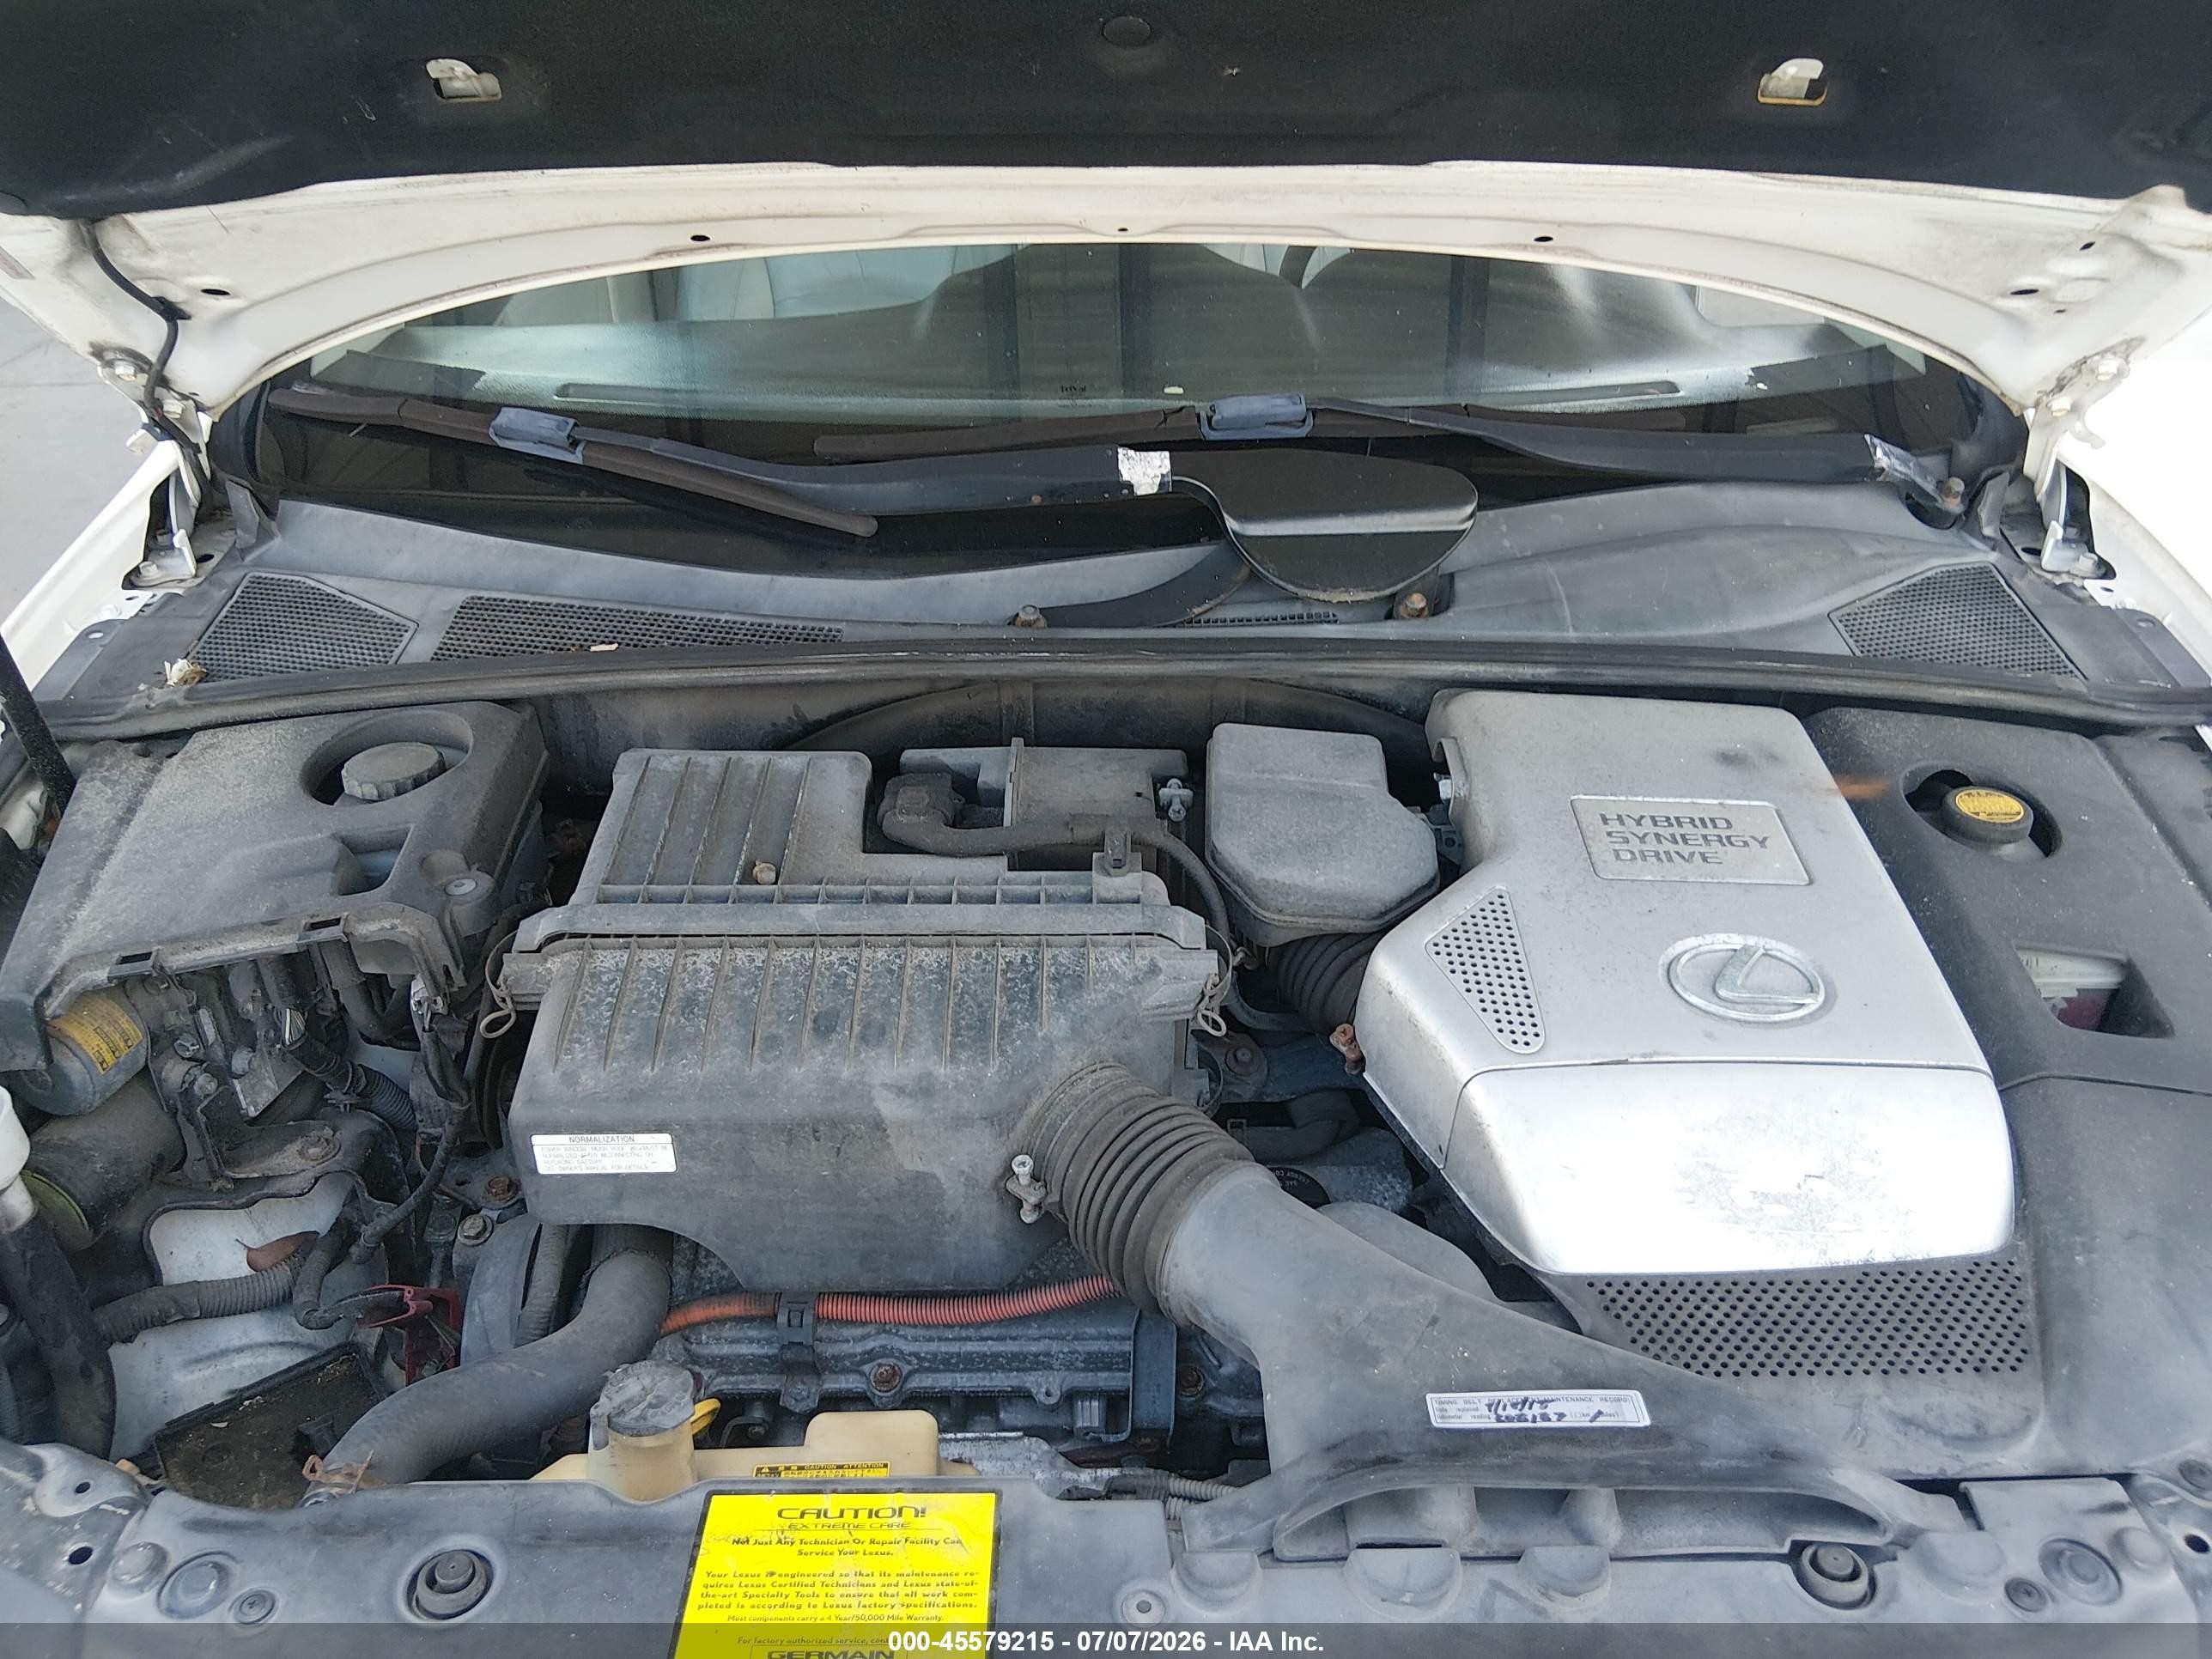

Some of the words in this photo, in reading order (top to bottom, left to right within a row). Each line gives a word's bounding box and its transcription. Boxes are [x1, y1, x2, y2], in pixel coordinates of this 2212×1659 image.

[1599, 813, 1733, 830] HYBRID
[1606, 830, 1770, 849] SYNERGY
[1612, 848, 1723, 865] DRIVE
[777, 1505, 927, 1519] CAUTION!
[732, 1536, 750, 1546] Not
[775, 1538, 795, 1547] Any
[869, 1537, 902, 1547] Repair
[904, 1537, 940, 1547] Facility
[778, 1571, 835, 1579] engineered
[742, 1591, 790, 1600] Specialty
[835, 1613, 885, 1622] Year/50,000
[906, 1613, 945, 1622] Warranty.
[753, 1637, 784, 1645] factory
[835, 1637, 868, 1645] service,
